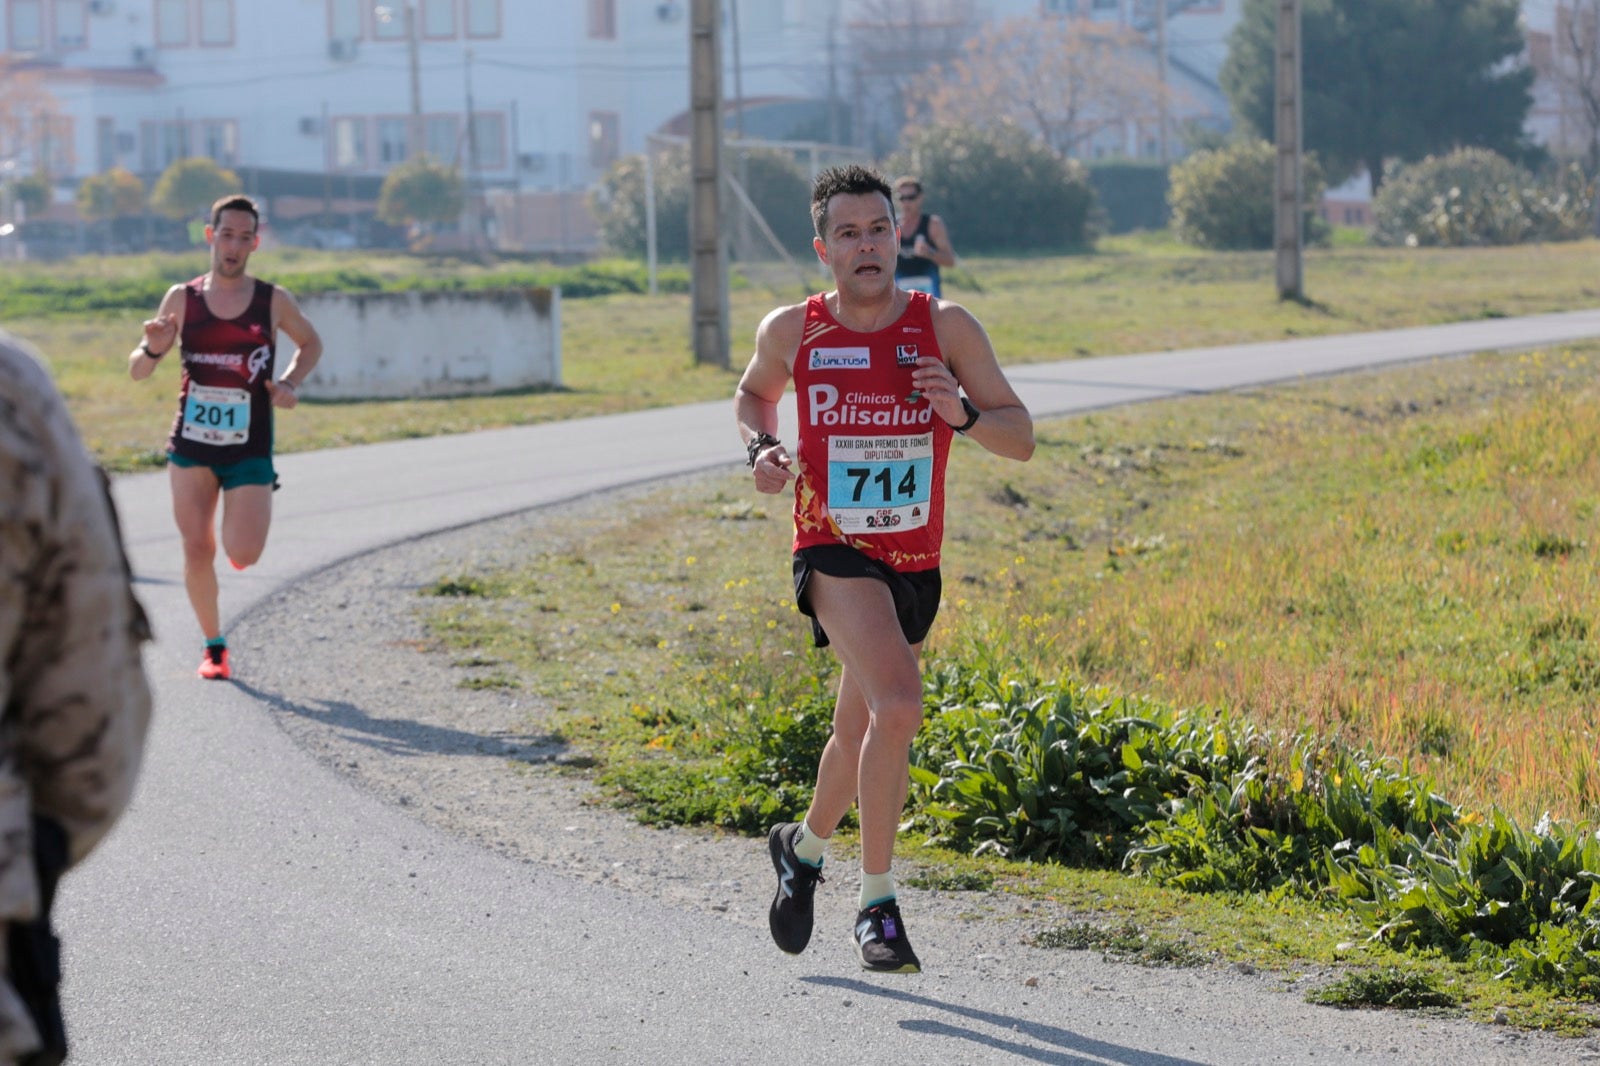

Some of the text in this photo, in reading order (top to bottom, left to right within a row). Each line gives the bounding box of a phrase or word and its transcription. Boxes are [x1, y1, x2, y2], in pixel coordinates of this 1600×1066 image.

[807, 383, 933, 426] Polisalud
[845, 392, 896, 404] Clínicas
[194, 404, 235, 427] 201
[835, 436, 929, 449] XXXIII GRAN PREMIO DE FONDO
[864, 450, 904, 460] DIPUTACIÓN
[847, 464, 916, 502] 714
